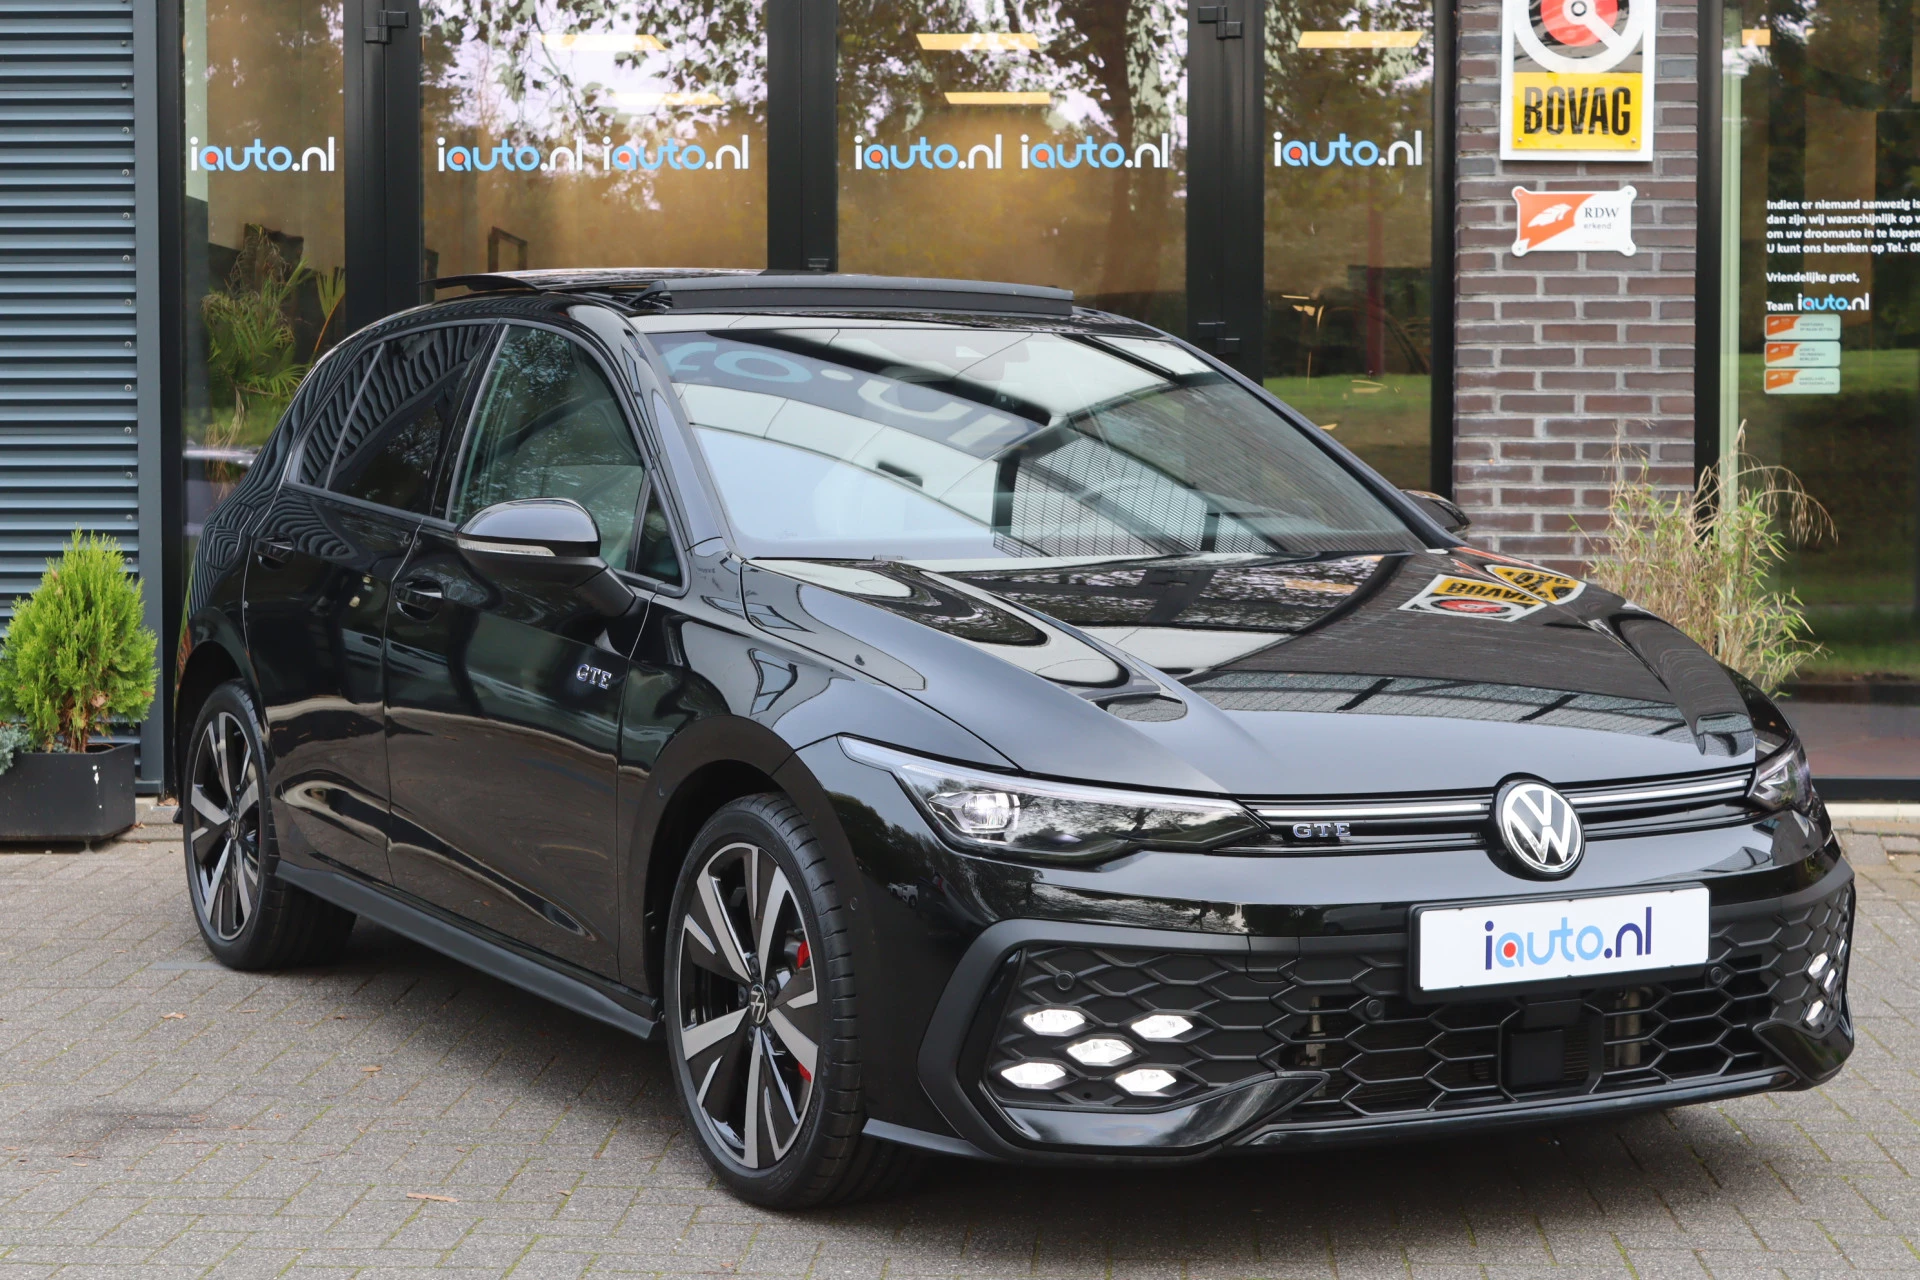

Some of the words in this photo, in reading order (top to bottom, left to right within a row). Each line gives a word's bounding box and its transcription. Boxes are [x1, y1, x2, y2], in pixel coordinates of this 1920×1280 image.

[1523, 86, 1631, 136] BOVAG
[190, 136, 335, 172] iauto.nl
[437, 136, 583, 172] iauto.nl
[603, 134, 749, 171] iauto.nl
[854, 134, 1002, 170] iauto.nl
[1021, 133, 1169, 169] iauto.nl
[1273, 130, 1423, 167] iauto.nl
[1584, 207, 1620, 218] RDW
[1766, 199, 1800, 210] Indien
[1801, 201, 1814, 210] er
[1814, 198, 1860, 210] niemand
[1862, 198, 1911, 211] aanwezig
[1583, 222, 1612, 230] erkend
[1766, 213, 1787, 224] dan
[1788, 213, 1807, 226] zijn
[1808, 213, 1825, 226] wij
[1826, 212, 1897, 226] waarschijnlijk
[1898, 215, 1913, 226] op
[1766, 230, 1784, 239] om
[1785, 230, 1803, 239] uw
[1804, 228, 1862, 239] droomauto
[1863, 227, 1875, 238] in
[1876, 228, 1888, 238] te
[1766, 243, 1776, 253] U
[1777, 242, 1801, 253] kunt
[1802, 244, 1822, 253] ons
[1823, 242, 1869, 253] bereiken
[1870, 244, 1884, 255] op
[1765, 272, 1827, 284] Vriendelijke
[1828, 272, 1860, 284] groet,
[1765, 301, 1794, 311] Team
[1797, 292, 1870, 311] iauto.nl
[576, 663, 612, 690] GTE
[1292, 822, 1351, 839] GTE
[1484, 906, 1652, 971] iauto.nl
